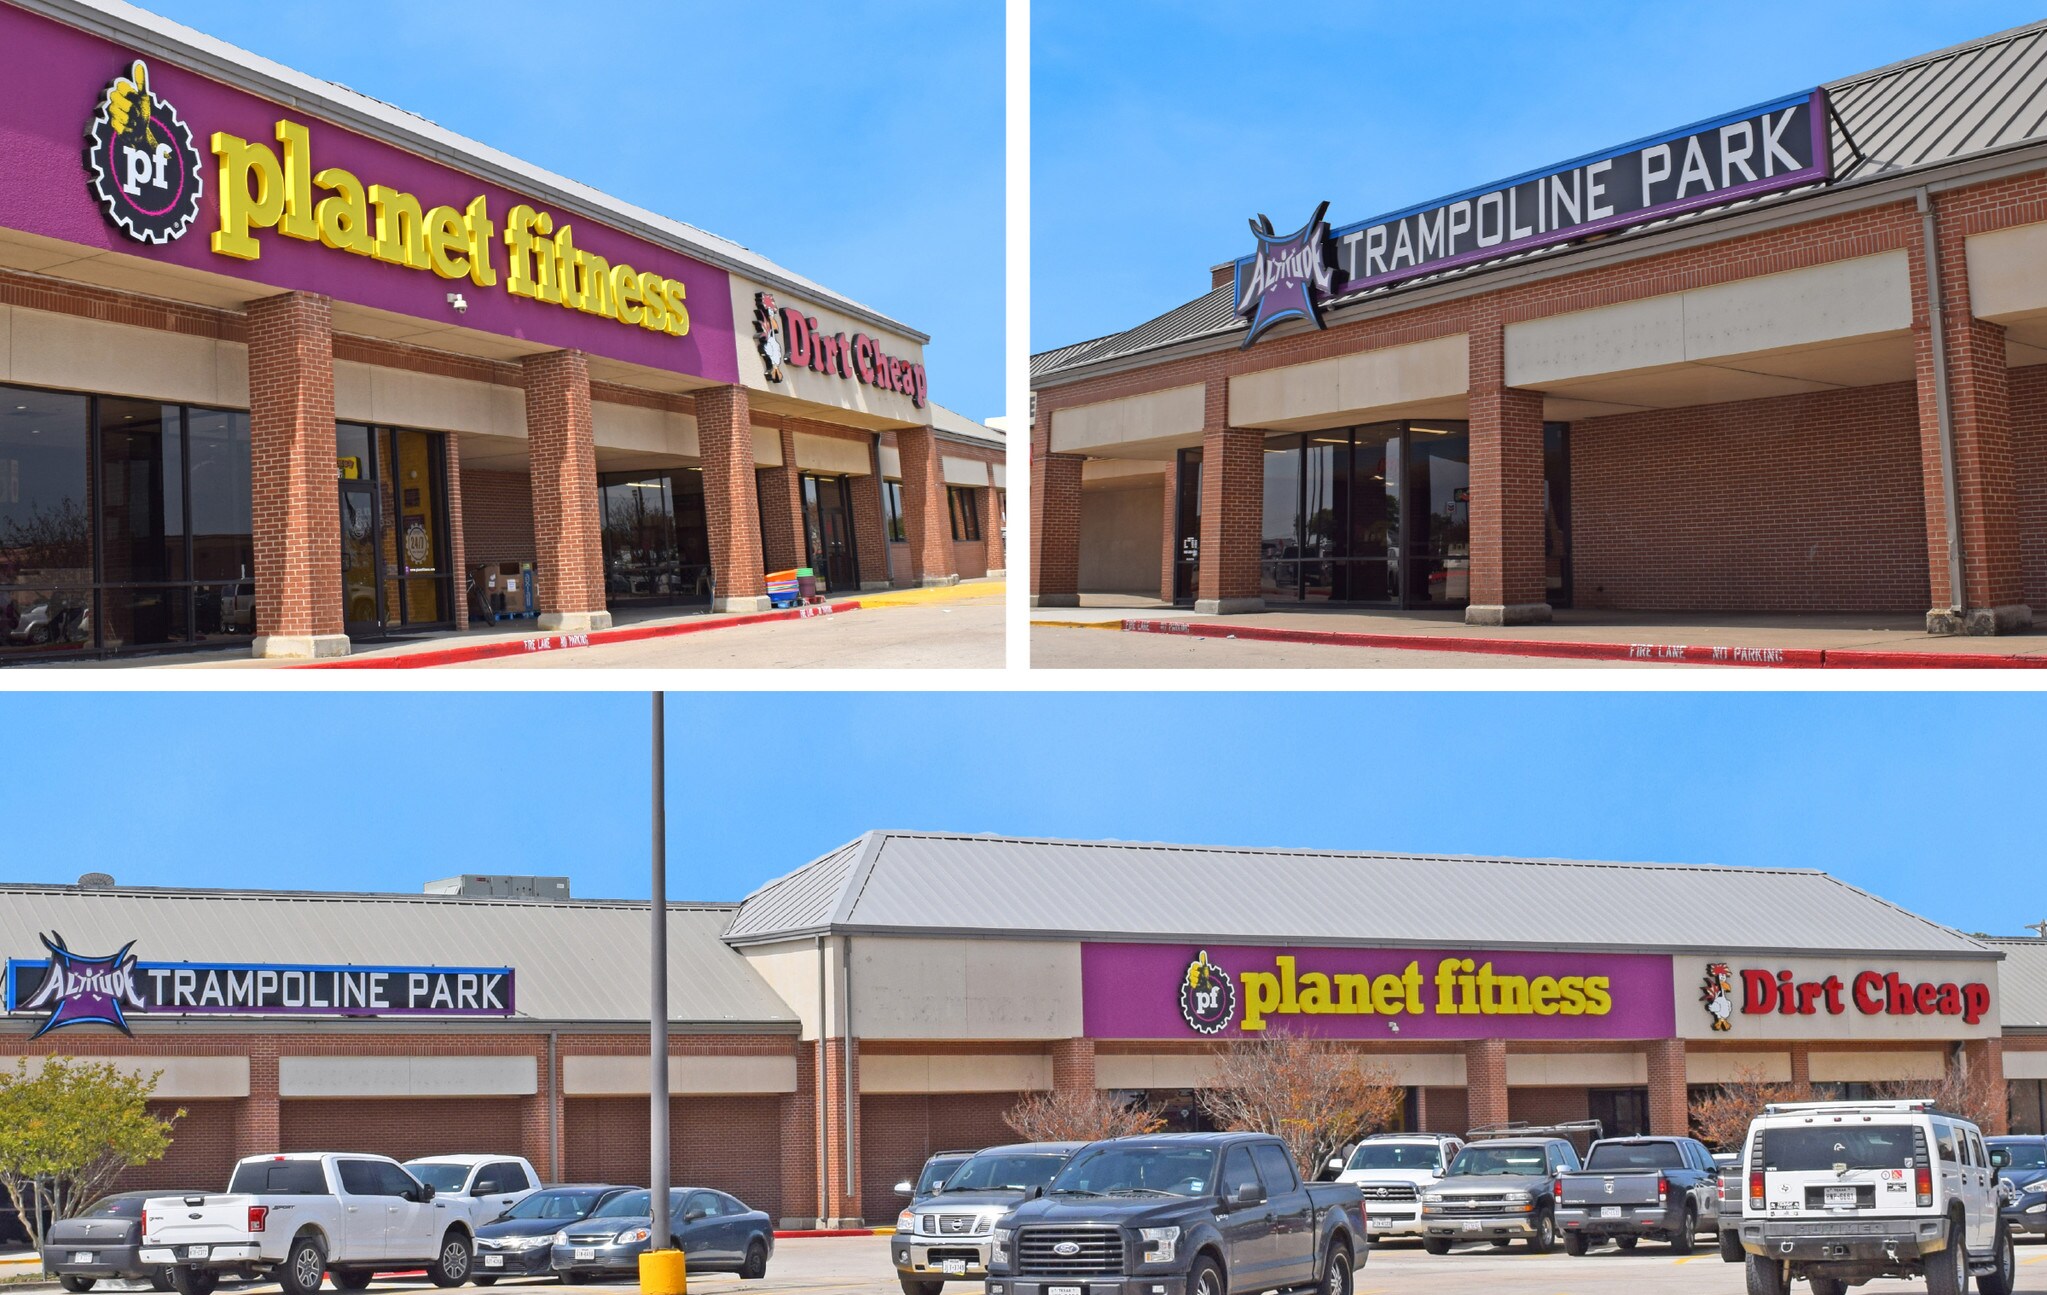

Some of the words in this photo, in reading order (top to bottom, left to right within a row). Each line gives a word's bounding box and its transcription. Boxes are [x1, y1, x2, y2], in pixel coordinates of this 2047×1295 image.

[123, 142, 171, 196] pf
[1343, 158, 1615, 282] TRAMPOLINE
[1641, 105, 1803, 208] PARK
[210, 118, 498, 288] planet
[503, 203, 691, 337] fitness
[779, 306, 854, 380] Dirt
[850, 332, 929, 409] Cheap
[523, 639, 536, 651] FIRE
[537, 637, 551, 650] LANE
[559, 635, 567, 648] NO
[568, 634, 589, 647] PARKING
[1629, 643, 1654, 658] FIRE
[1658, 644, 1687, 659] LANE
[1712, 646, 1728, 661] NO
[1733, 646, 1784, 662] PARKING
[148, 969, 389, 1008] TRAMPOLINE
[408, 973, 505, 1009] PARK
[1195, 986, 1219, 1017] pf
[1241, 954, 1425, 1032] planet
[1433, 957, 1612, 1017] fitness
[1741, 967, 1846, 1017] Dirt
[1852, 969, 1990, 1026] Cheap
[1795, 1223, 1886, 1235] HUMMER
